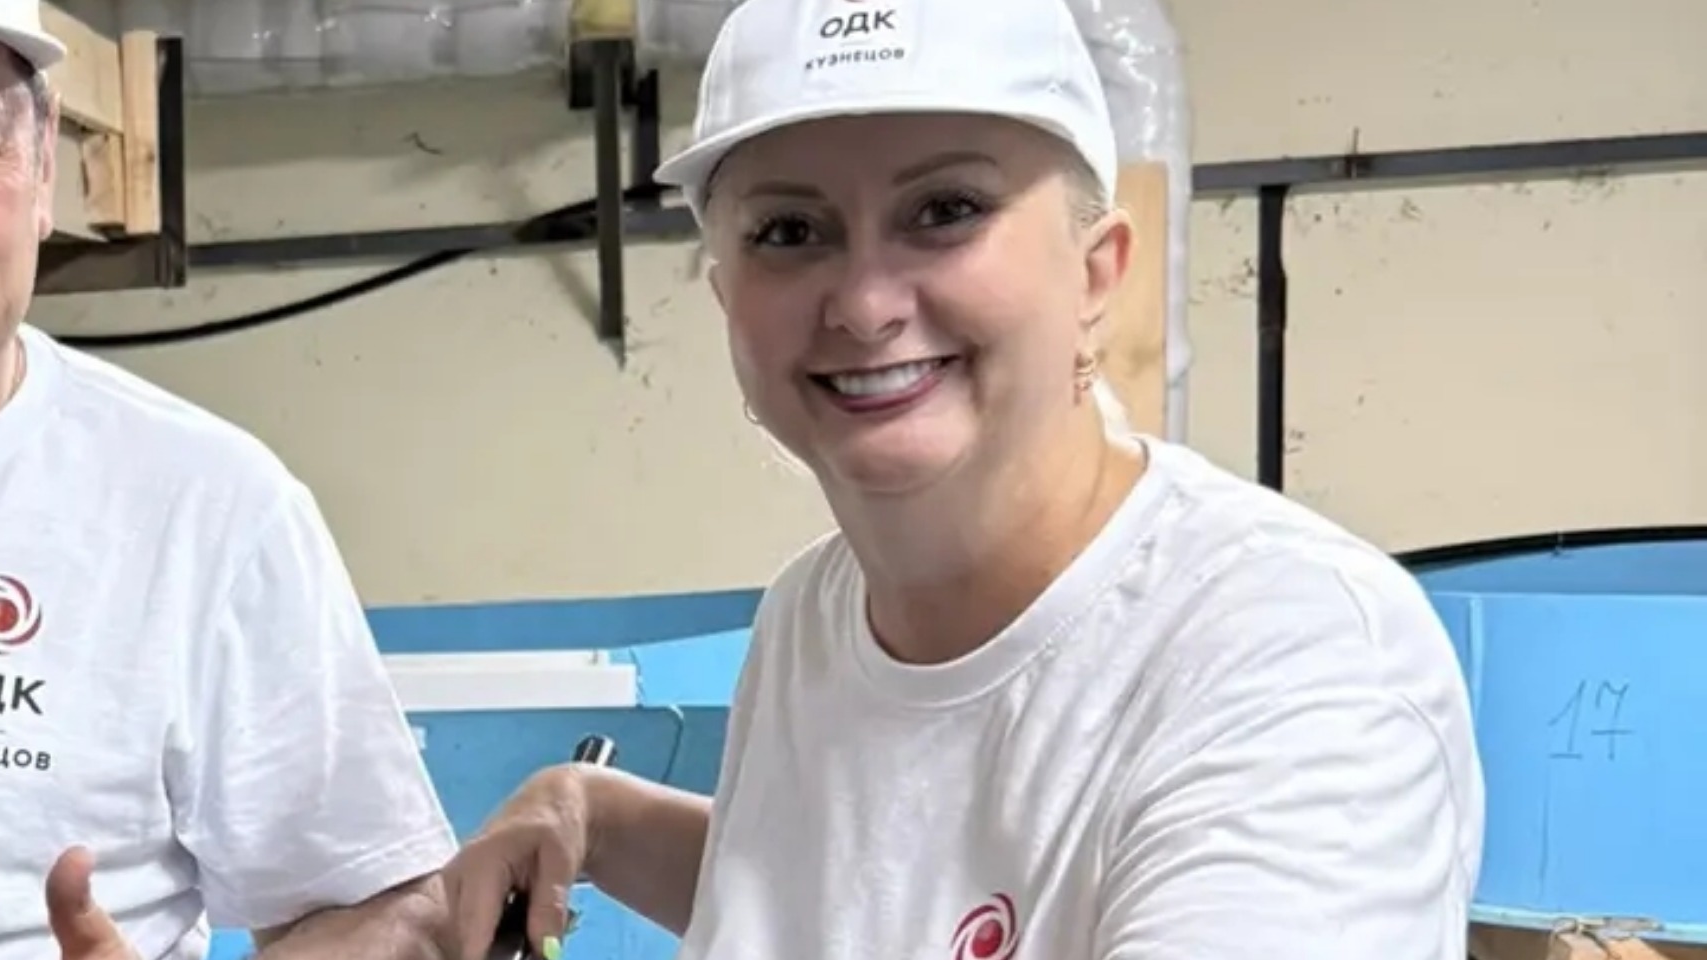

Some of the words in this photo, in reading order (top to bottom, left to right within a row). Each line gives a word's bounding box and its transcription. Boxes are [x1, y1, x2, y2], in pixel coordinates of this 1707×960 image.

[819, 9, 896, 38] ОДК
[804, 47, 905, 72] КУЗНЕЦОВ
[1547, 679, 1636, 761] 17
